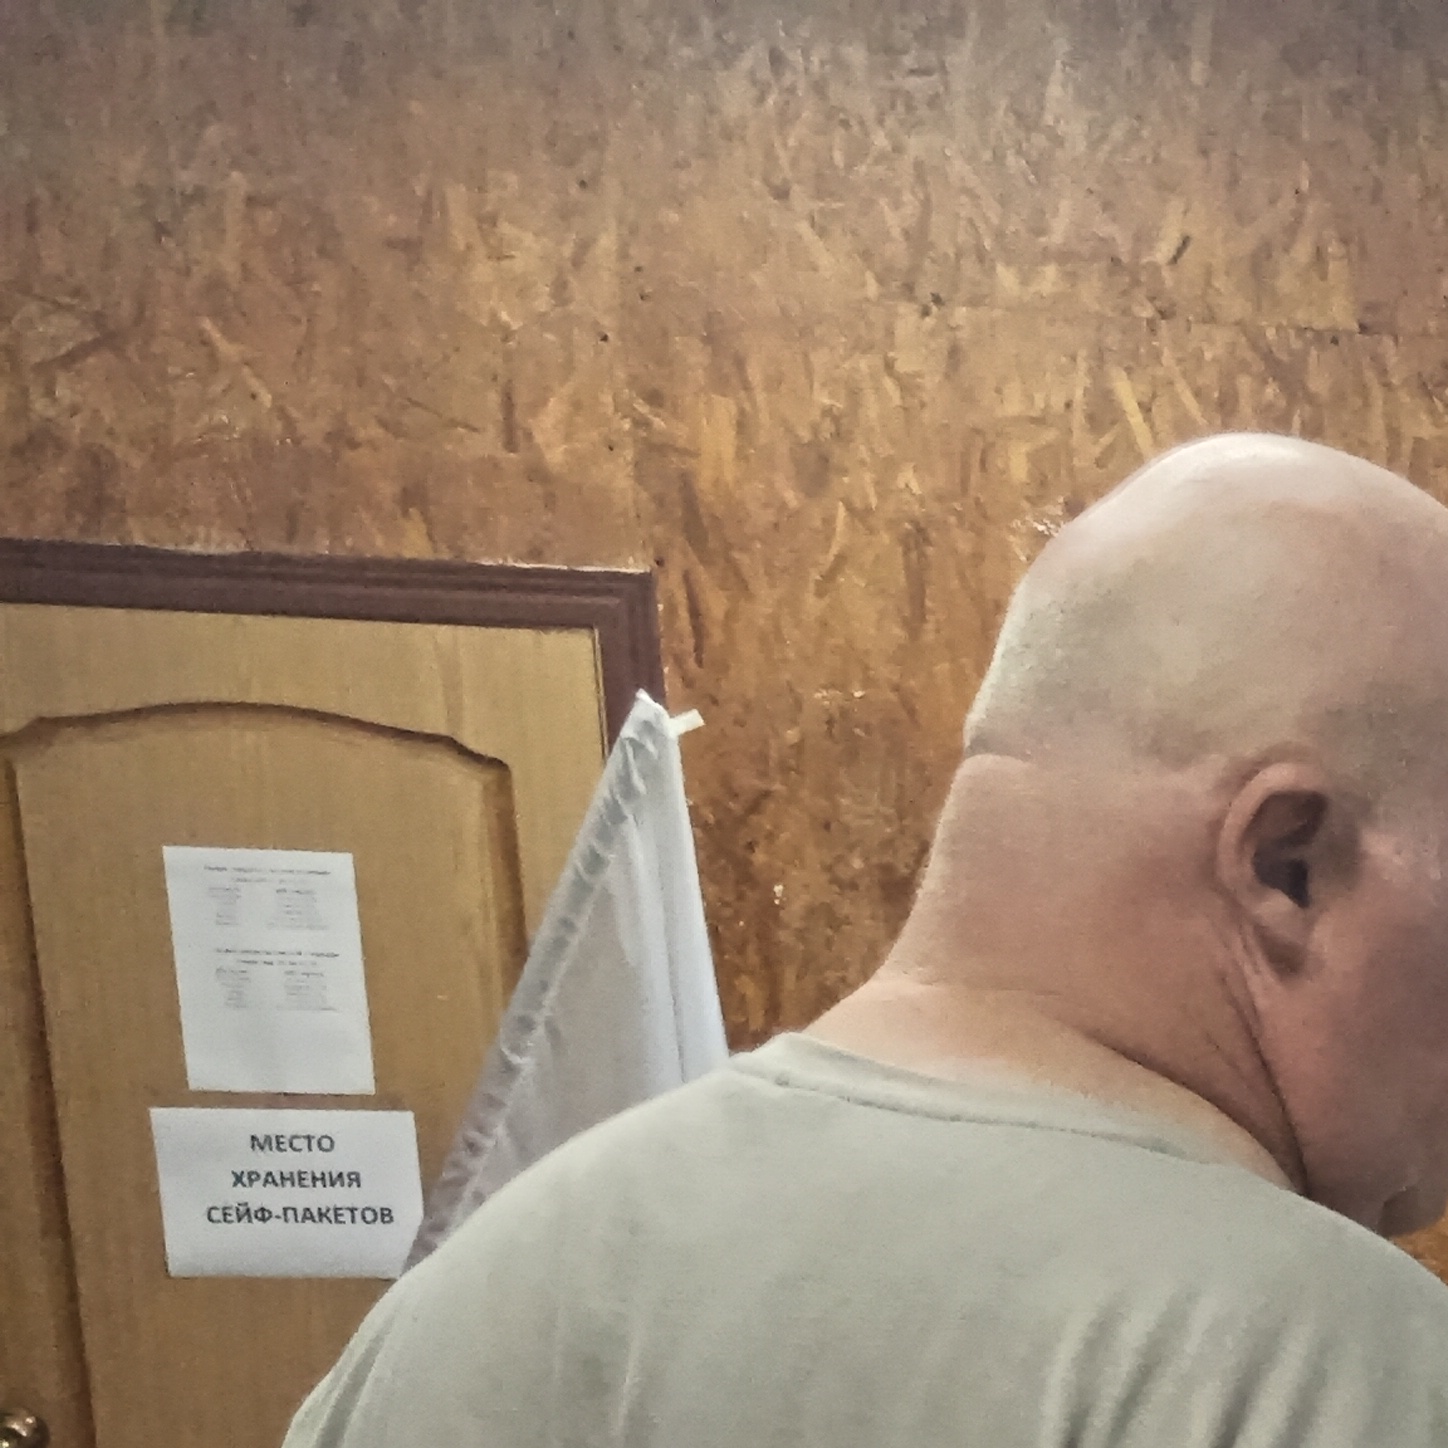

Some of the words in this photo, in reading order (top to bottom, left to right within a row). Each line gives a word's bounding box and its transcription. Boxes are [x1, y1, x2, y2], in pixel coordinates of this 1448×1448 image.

[250, 1134, 336, 1153] МЕСТО
[231, 1169, 362, 1189] ХРАНЕНИЯ
[206, 1201, 395, 1225] СЕЙФ-ПАКЕТОВ
